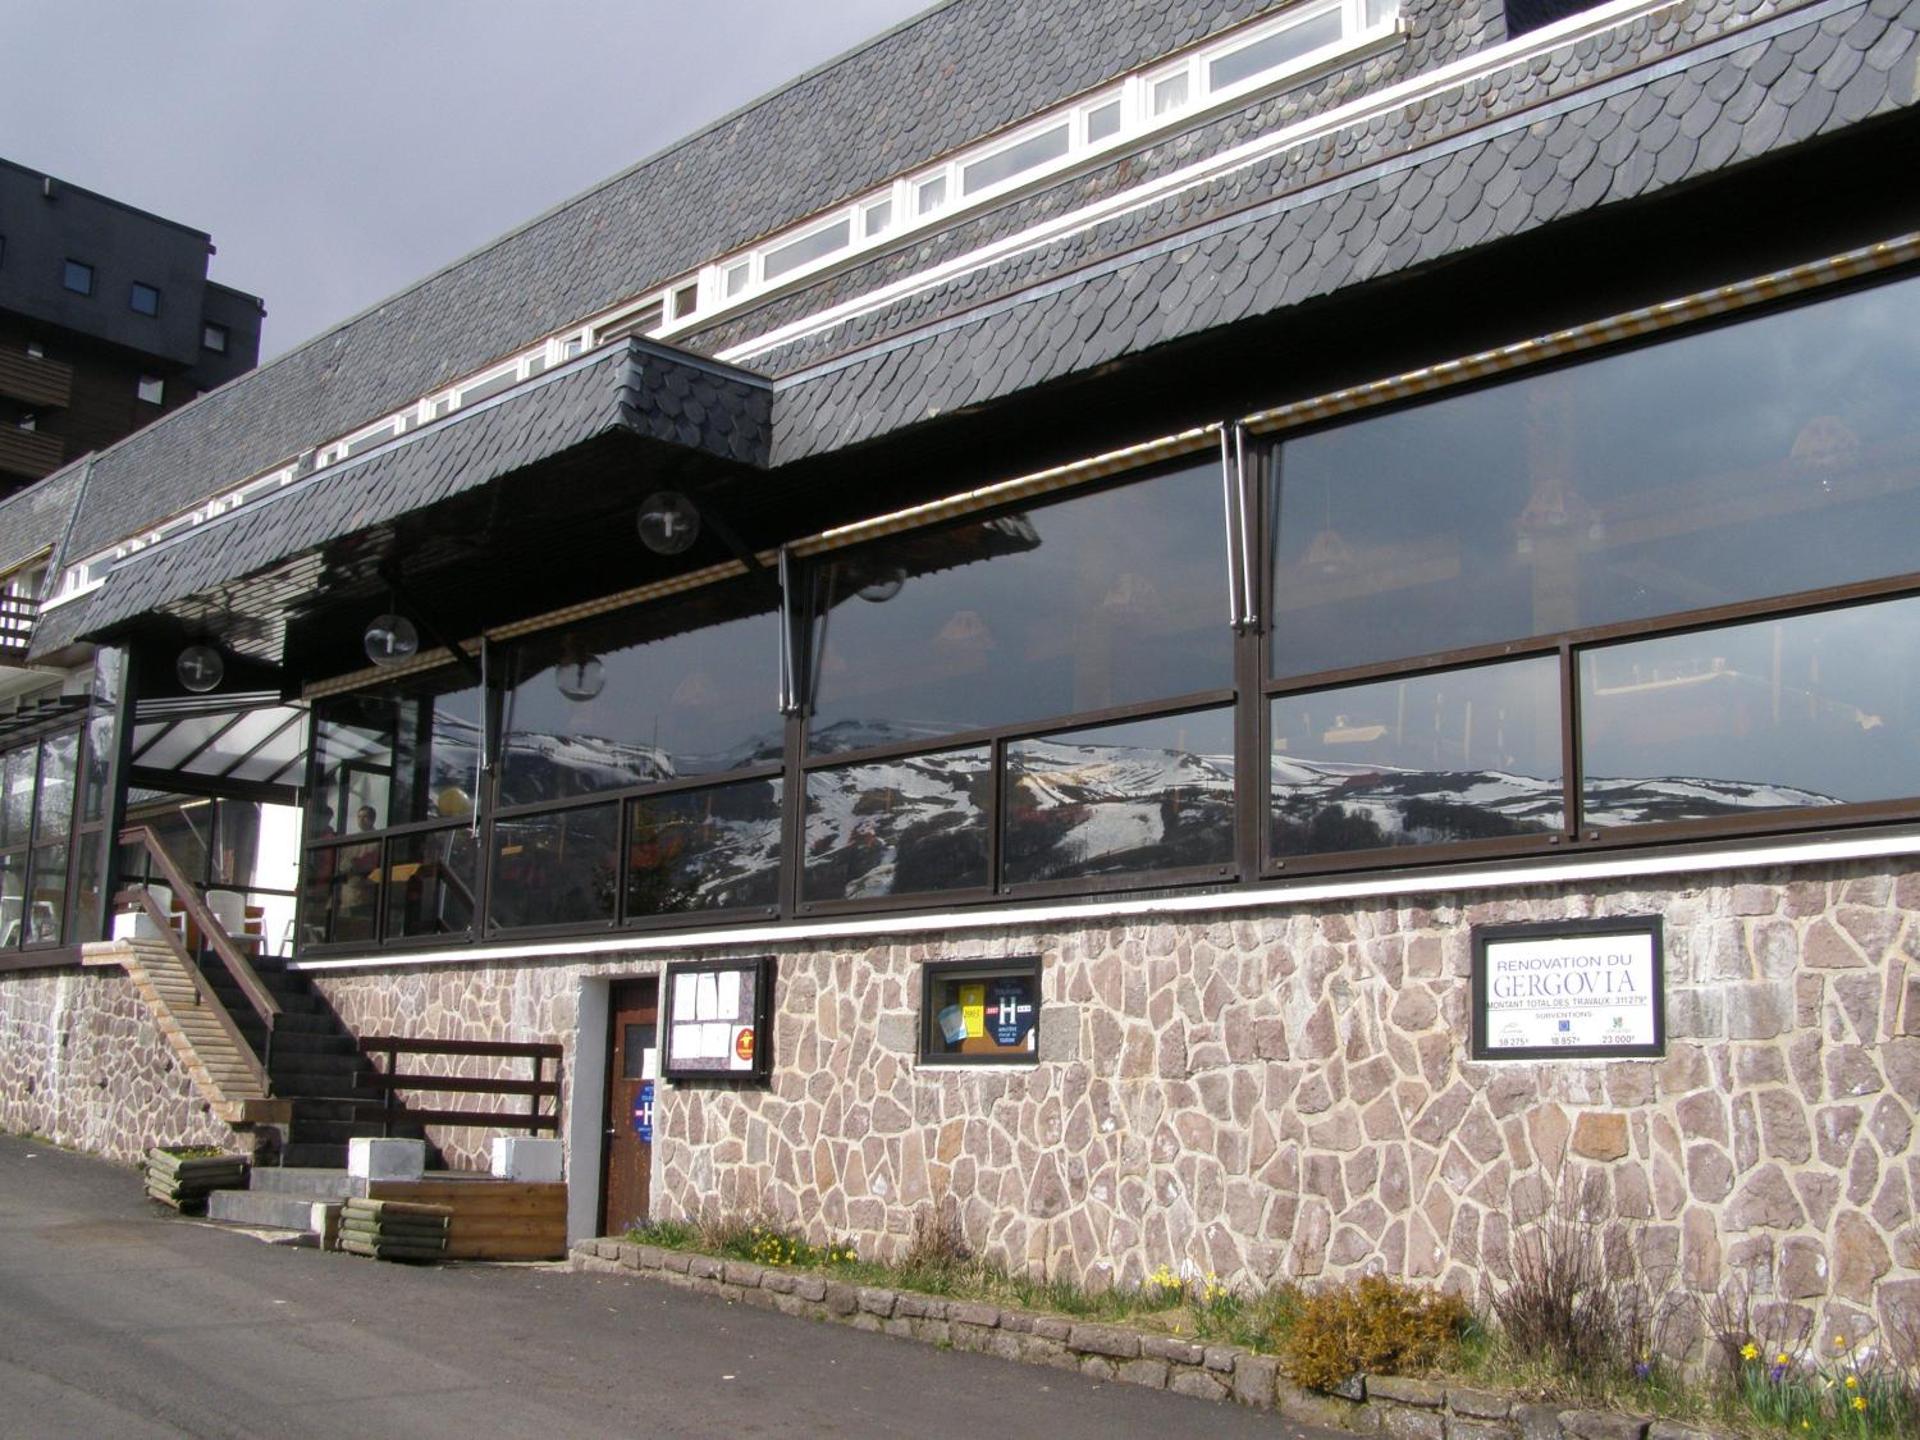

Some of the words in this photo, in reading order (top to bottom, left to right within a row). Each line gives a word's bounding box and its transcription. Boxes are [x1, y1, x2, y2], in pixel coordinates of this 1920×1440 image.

[1497, 956, 1601, 972] RENOVATION
[1607, 954, 1632, 967] DU
[1494, 970, 1636, 998] GERGOVIA
[999, 996, 1017, 1025] H
[1526, 998, 1550, 1008] TOTAL
[1553, 998, 1570, 1007] DES
